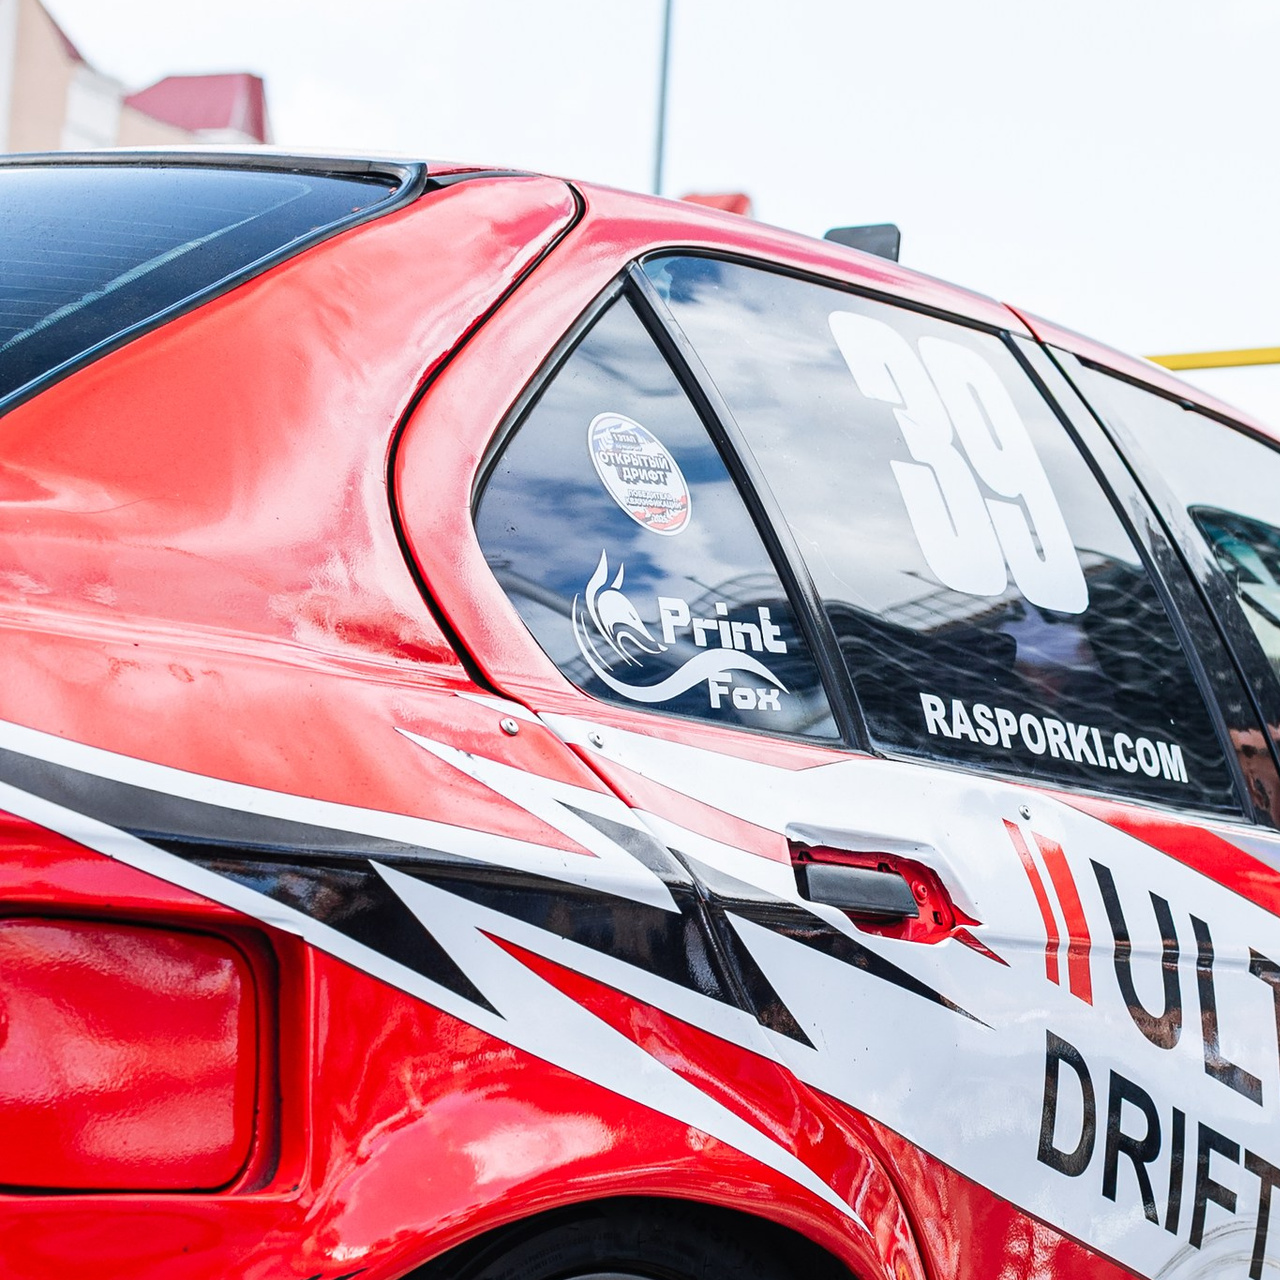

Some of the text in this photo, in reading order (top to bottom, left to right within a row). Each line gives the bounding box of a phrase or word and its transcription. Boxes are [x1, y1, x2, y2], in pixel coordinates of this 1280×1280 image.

[599, 450, 670, 470] ОТКРЫТЫЙ
[622, 466, 666, 483] ДРИФТ
[828, 310, 1090, 615] 39
[657, 596, 788, 655] Print
[709, 673, 782, 712] Fox
[919, 692, 1190, 784] RASPORKI.COM
